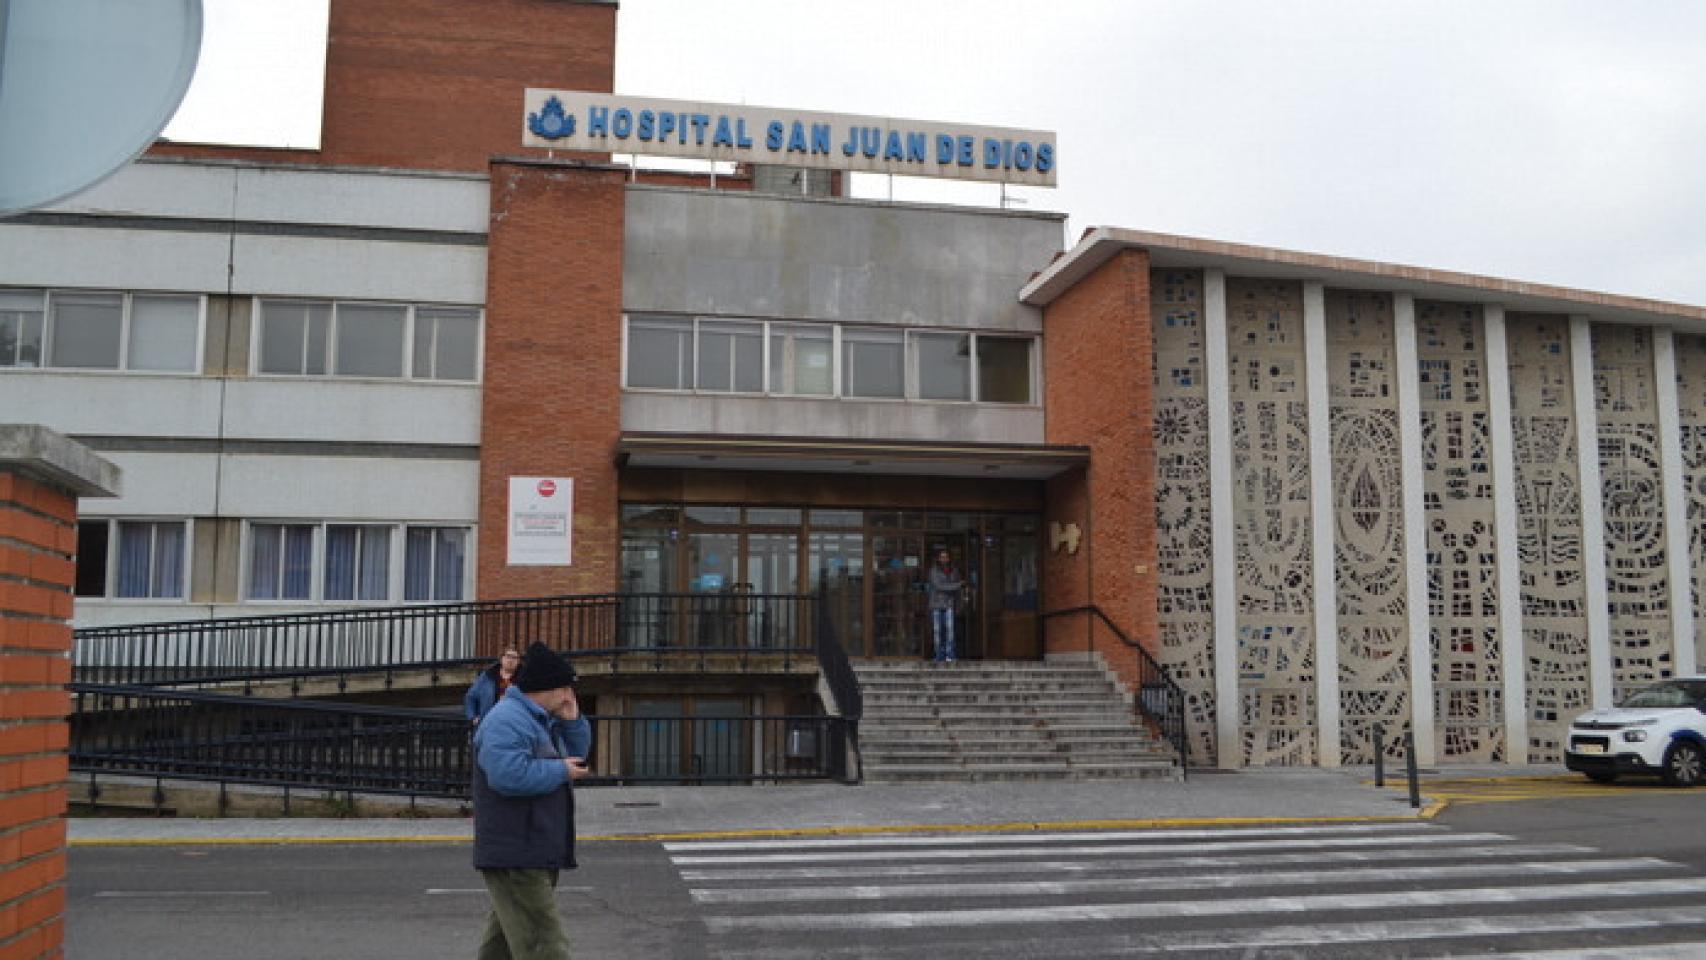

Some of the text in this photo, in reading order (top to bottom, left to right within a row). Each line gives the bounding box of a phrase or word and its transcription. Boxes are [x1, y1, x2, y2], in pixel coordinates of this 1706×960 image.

[587, 106, 1056, 172] HOSPITAL SAN JUAN DE DIOS
